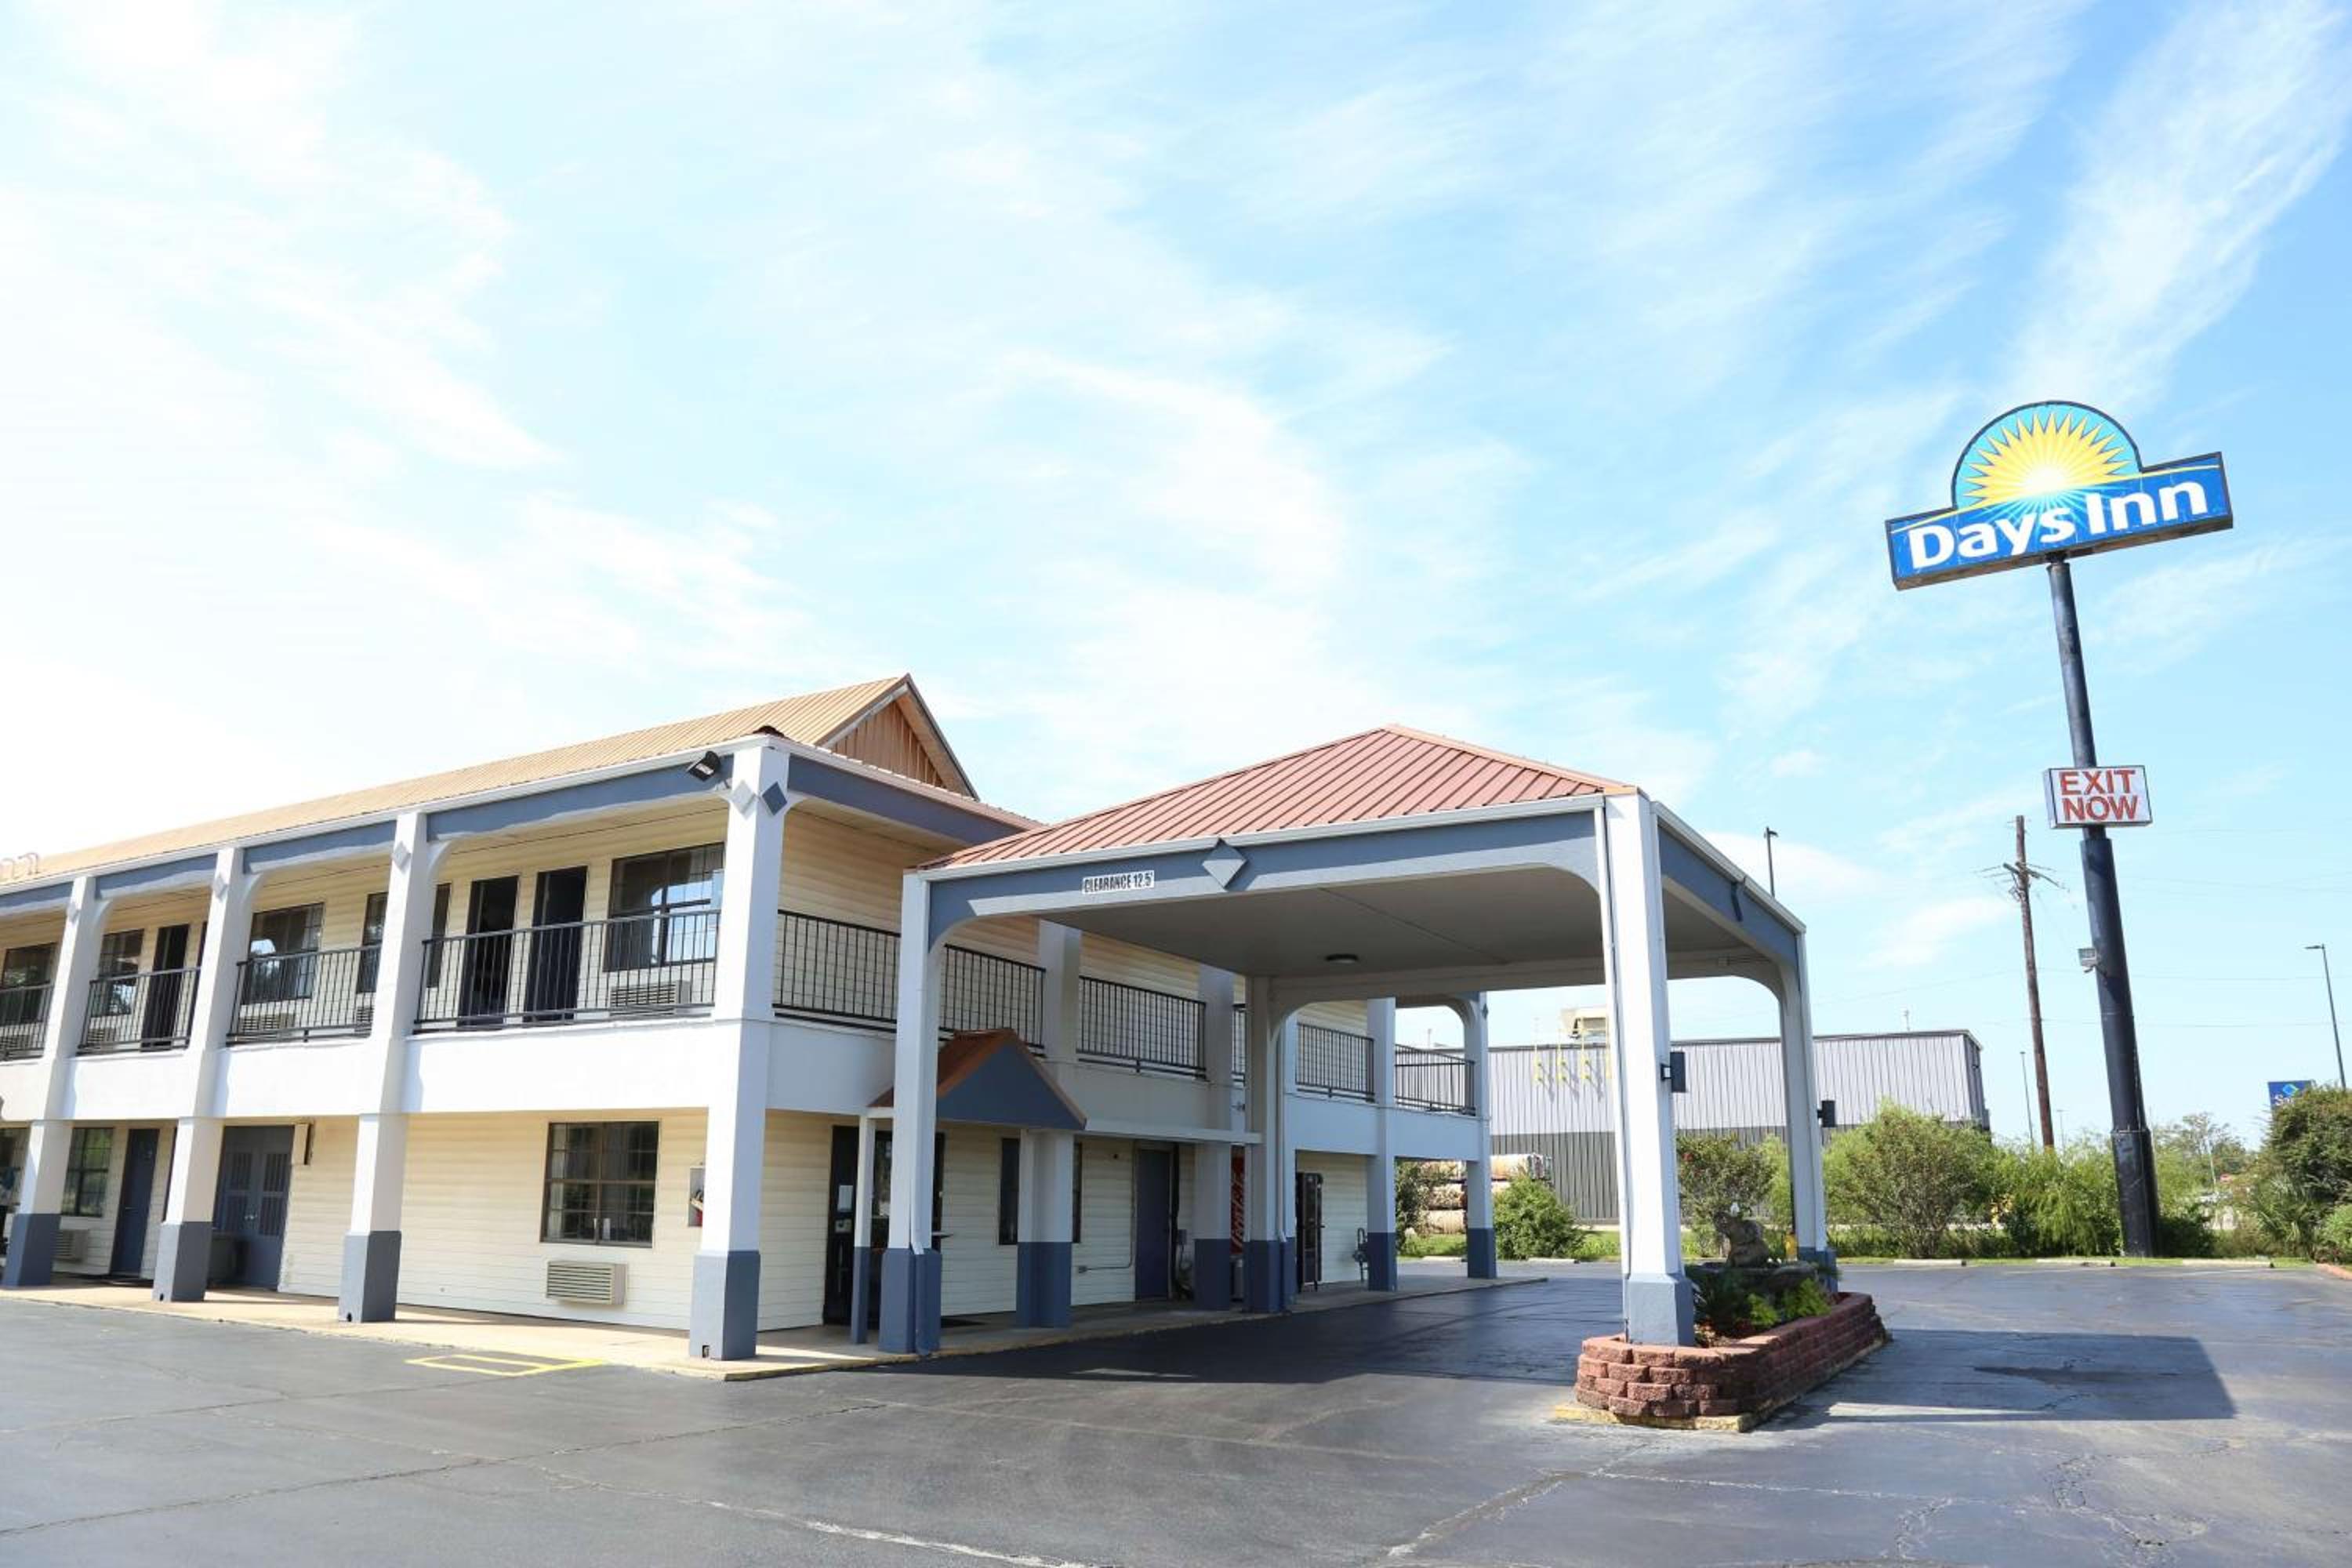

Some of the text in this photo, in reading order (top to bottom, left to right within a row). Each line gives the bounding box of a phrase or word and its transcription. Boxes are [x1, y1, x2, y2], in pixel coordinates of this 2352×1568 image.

[1907, 481, 2209, 568] Days Inn
[2059, 770, 2136, 795] EXIT
[2062, 795, 2138, 822] NOW
